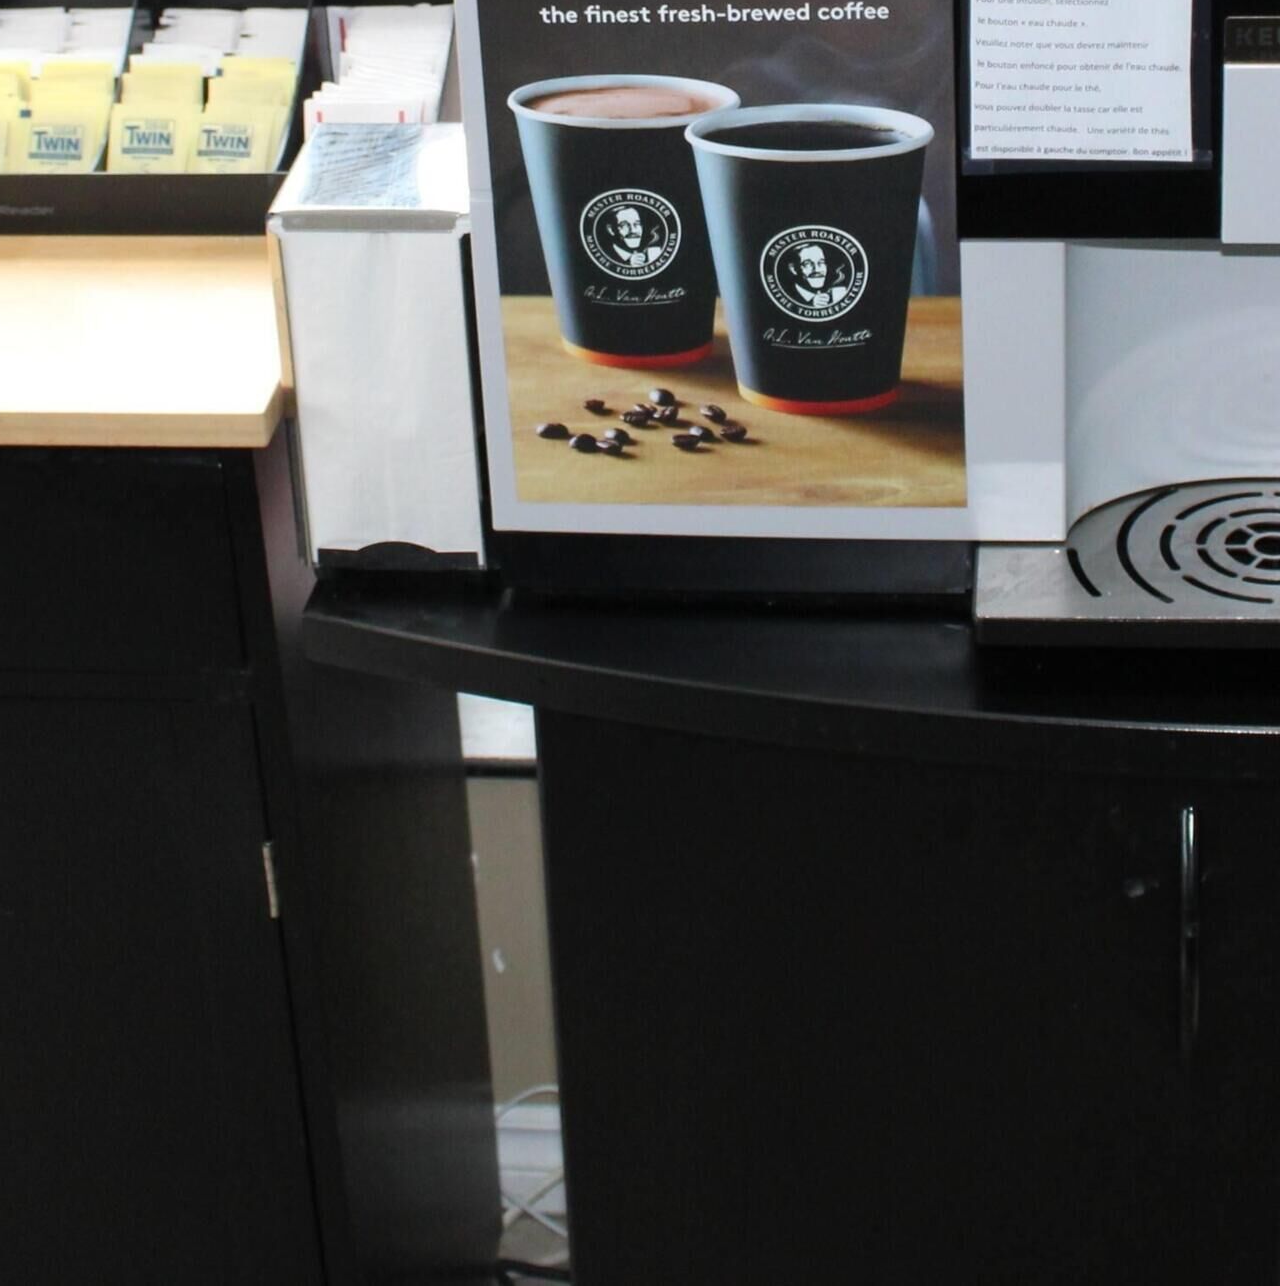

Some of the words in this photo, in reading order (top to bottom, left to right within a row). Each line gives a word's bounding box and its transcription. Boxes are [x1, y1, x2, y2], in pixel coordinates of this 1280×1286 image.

[540, 6, 578, 23] the
[585, 5, 650, 23] finest
[657, 4, 809, 23] fresh-brewed
[818, 2, 889, 20] coffee
[33, 131, 80, 151] TWIN
[125, 126, 170, 145] TWIN
[202, 129, 249, 149] TWIN
[588, 194, 622, 218] MASTER
[627, 194, 671, 217] ROASTER
[769, 232, 806, 257] MASTER
[811, 230, 857, 255] ROASTER
